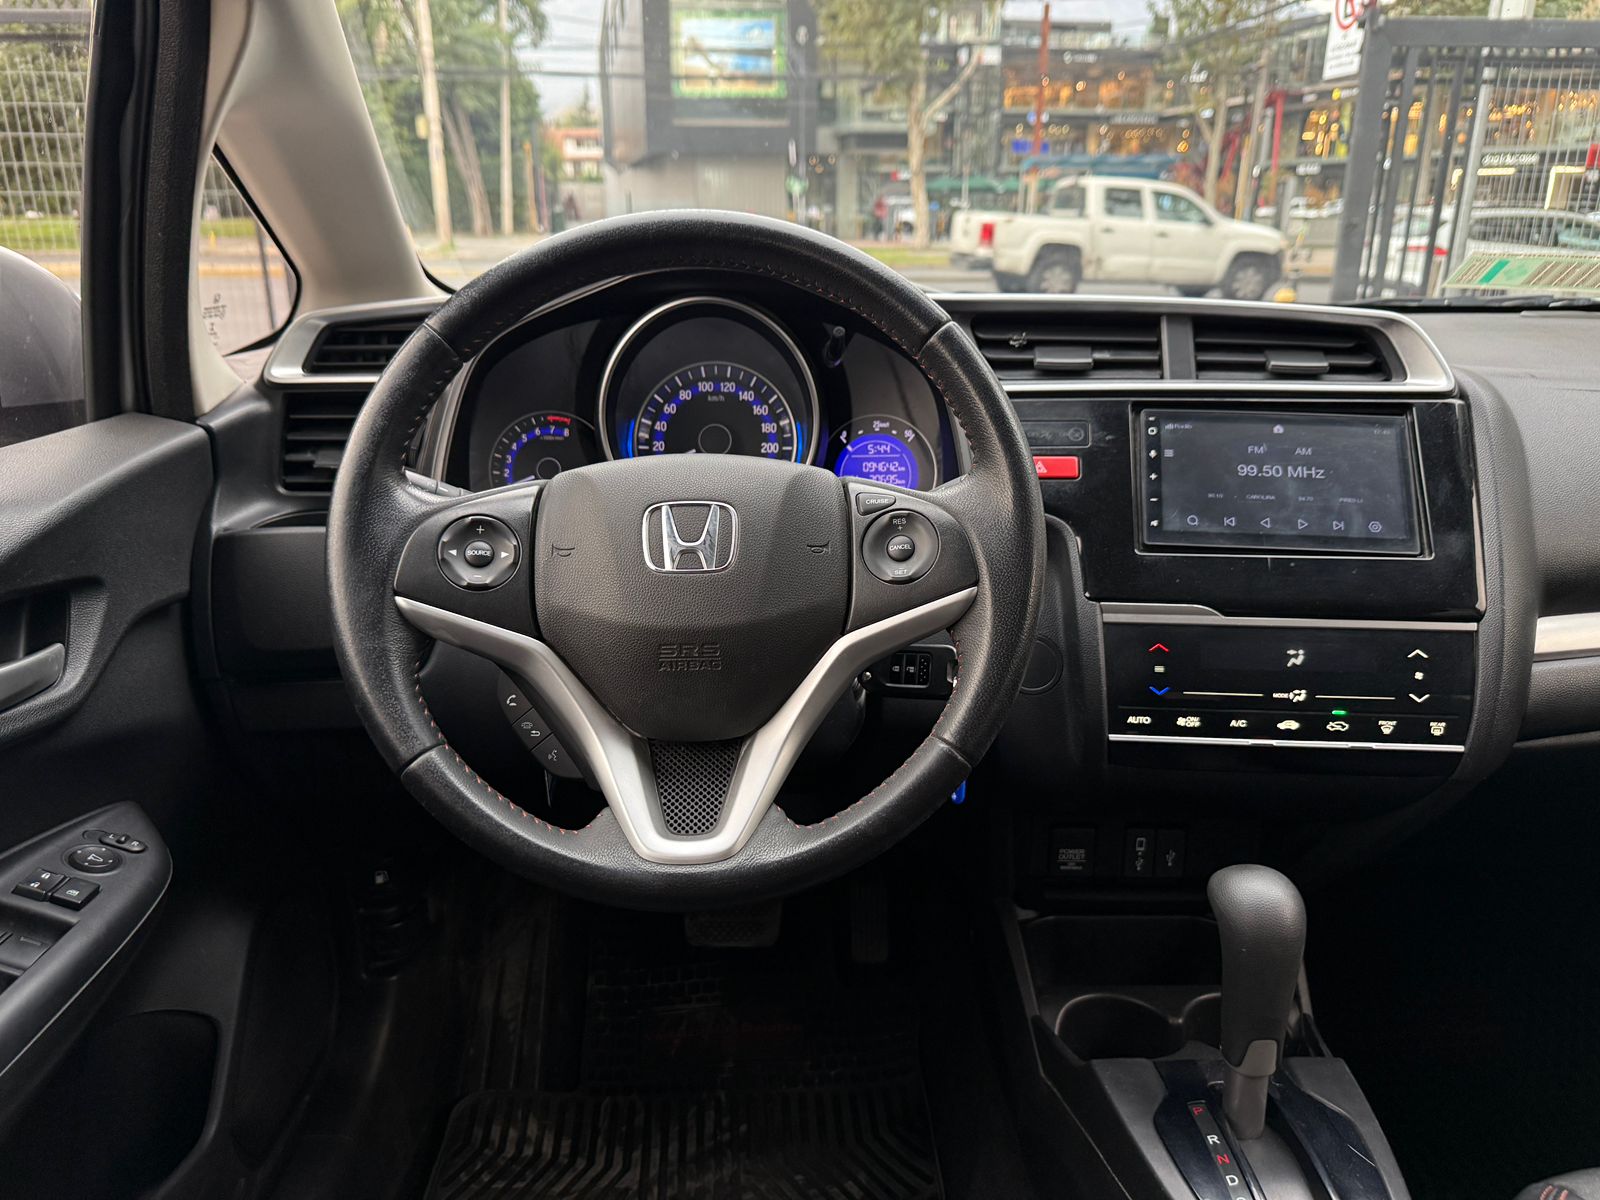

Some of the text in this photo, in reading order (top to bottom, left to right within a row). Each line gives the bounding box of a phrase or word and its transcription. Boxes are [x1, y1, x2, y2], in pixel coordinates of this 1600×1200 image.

[698, 382, 713, 392] 100
[720, 382, 735, 392] 120
[679, 390, 692, 400] 80
[739, 391, 754, 401] 140
[664, 403, 676, 414] 60
[753, 405, 768, 416] 160
[535, 427, 541, 435] 6
[550, 425, 555, 434] 7
[654, 421, 667, 431] 40
[761, 423, 777, 434] 180
[564, 428, 570, 437] 8
[521, 434, 528, 442] 5
[511, 442, 517, 451] 4
[653, 441, 665, 451] 20
[761, 442, 779, 453] 200
[867, 444, 891, 455] 5:44
[1247, 445, 1313, 456] FM AM
[506, 454, 512, 463] 3
[503, 468, 510, 477] 2
[1237, 463, 1326, 479] 99.50 MHz
[889, 543, 912, 551] CANCEL
[660, 644, 720, 657] SRS
[659, 661, 722, 671] AIRBAG
[1126, 715, 1151, 725] AUTO
[1229, 719, 1247, 728] A/C
[1206, 1134, 1221, 1145] R
[1216, 1153, 1231, 1165] N
[1225, 1174, 1239, 1186] D
